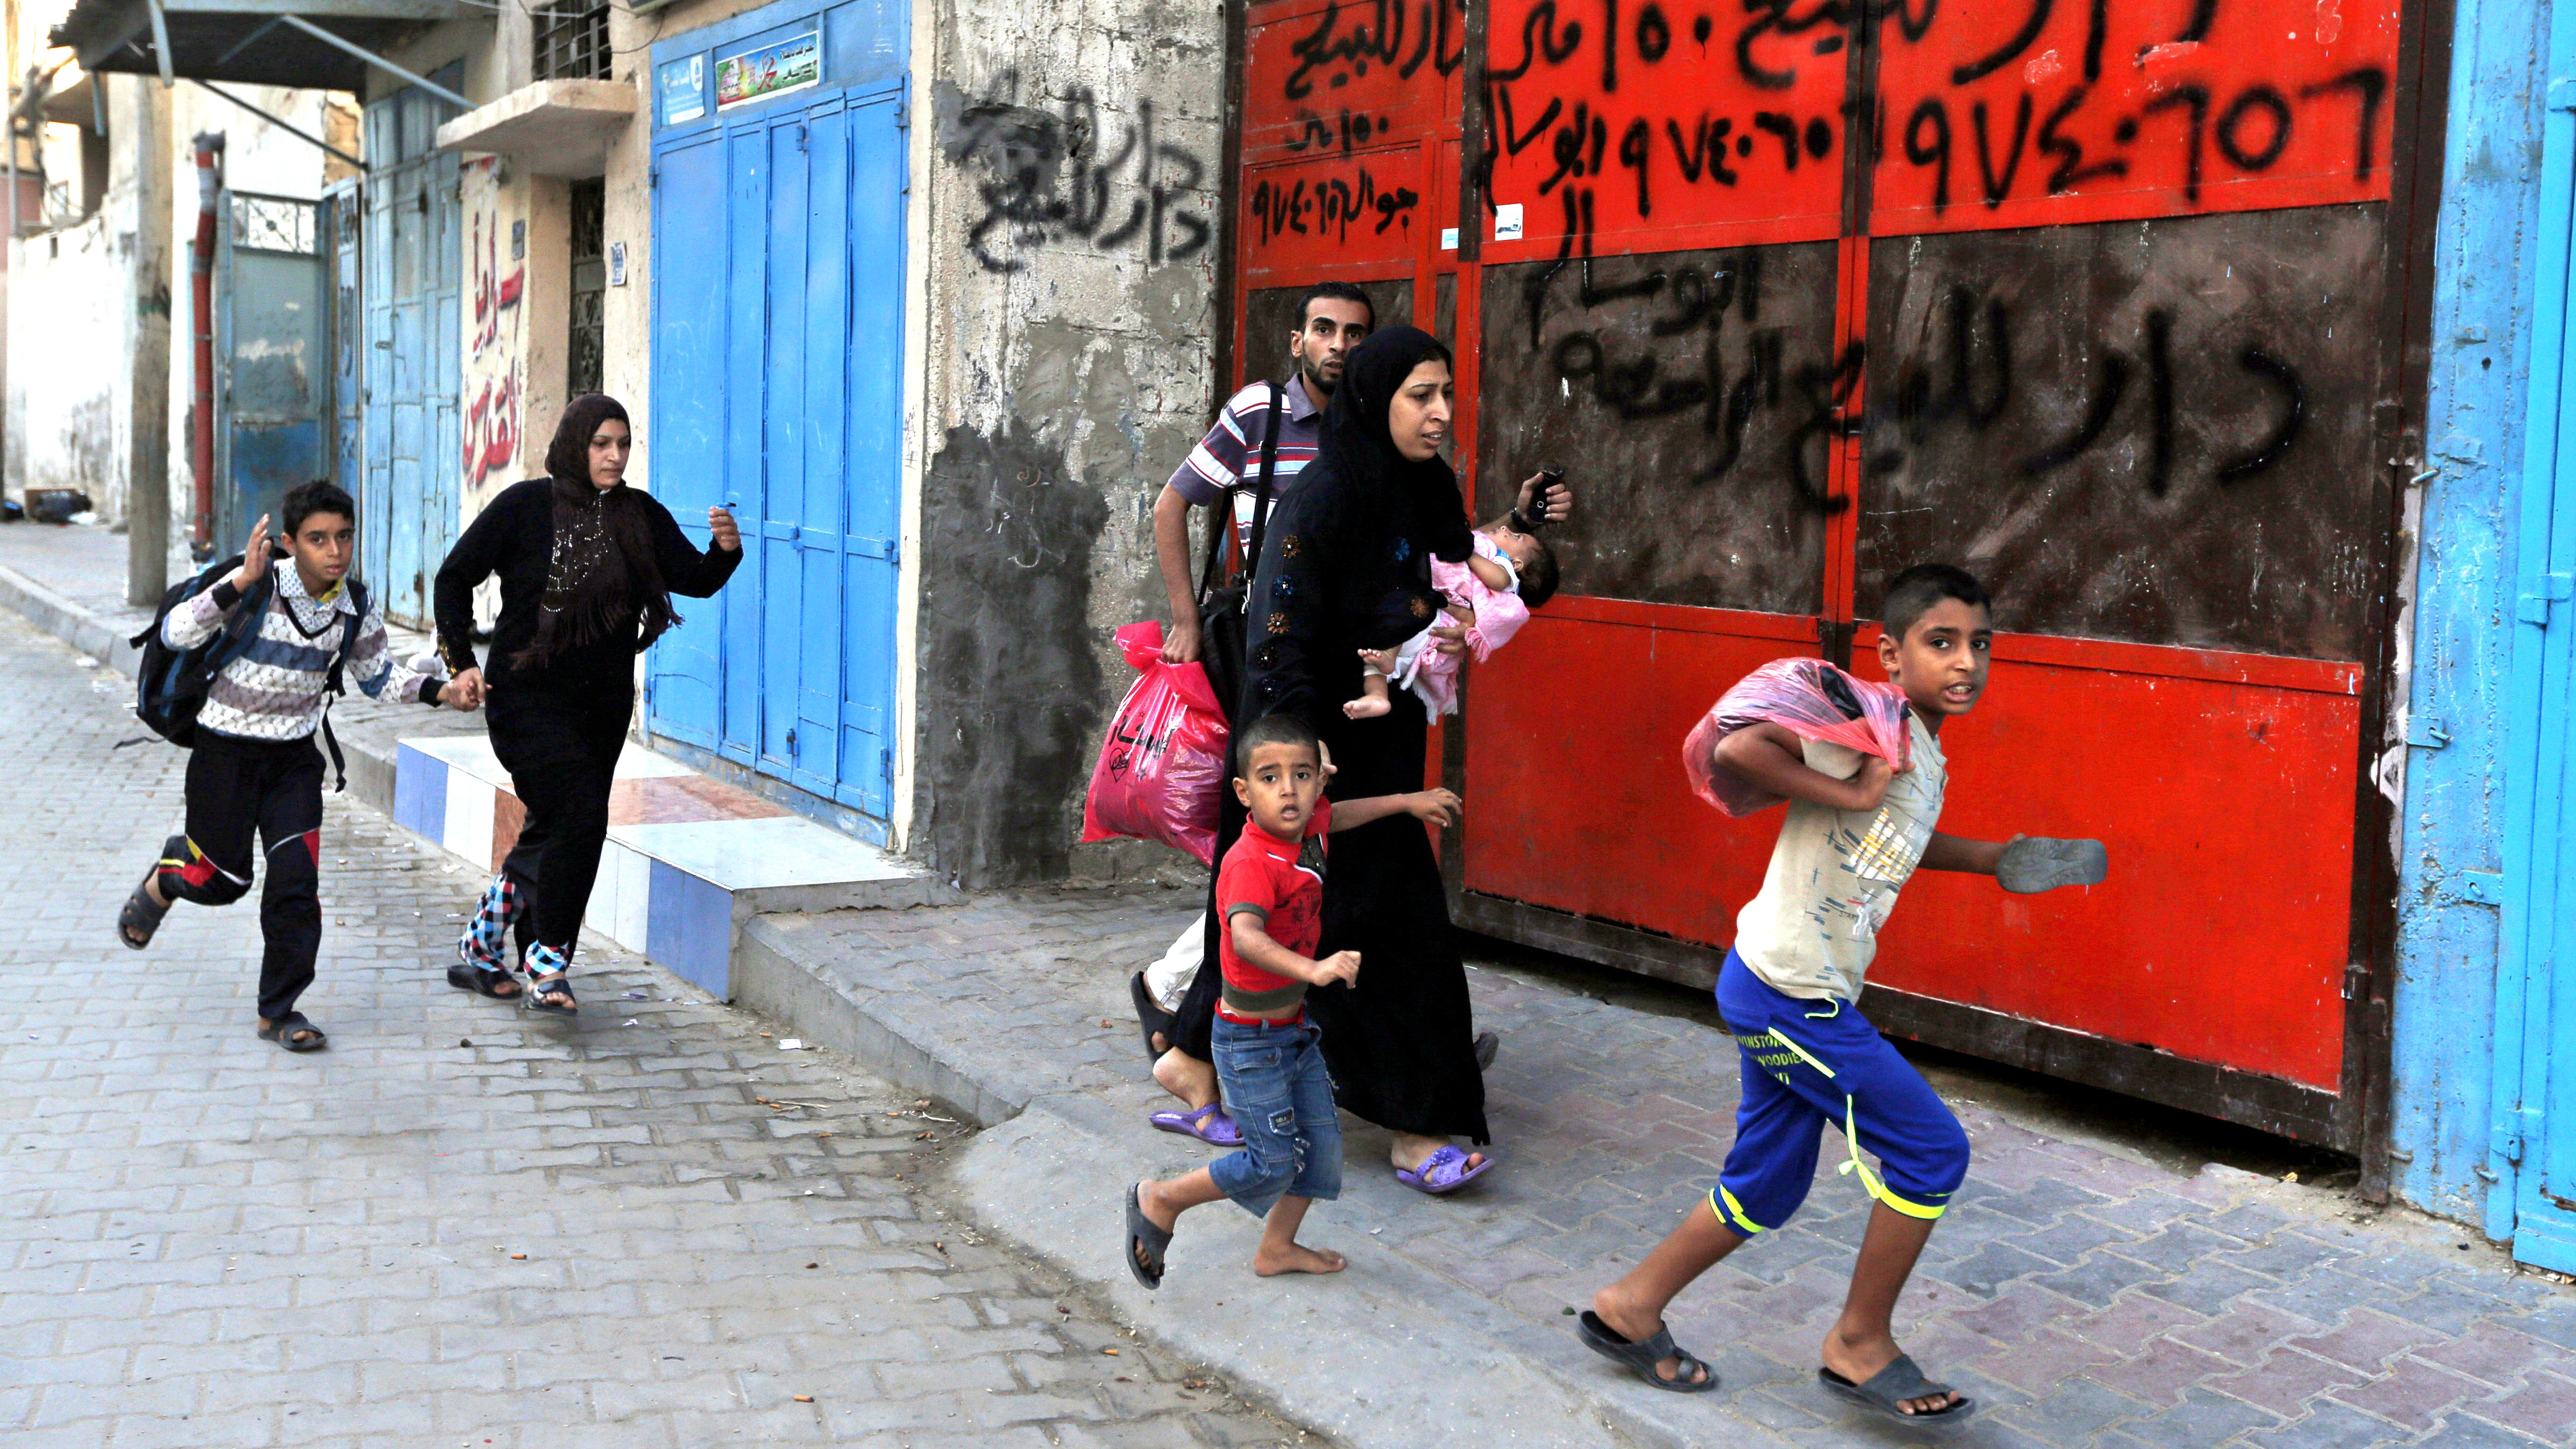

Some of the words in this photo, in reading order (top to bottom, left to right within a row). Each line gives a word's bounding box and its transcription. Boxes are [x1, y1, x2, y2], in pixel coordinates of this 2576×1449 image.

[1906, 67, 2385, 214] ٩٧٤٠٦٥٦
[1097, 185, 1212, 266] دار
[1791, 287, 2012, 514] للبيع
[2024, 308, 2307, 497] دار
